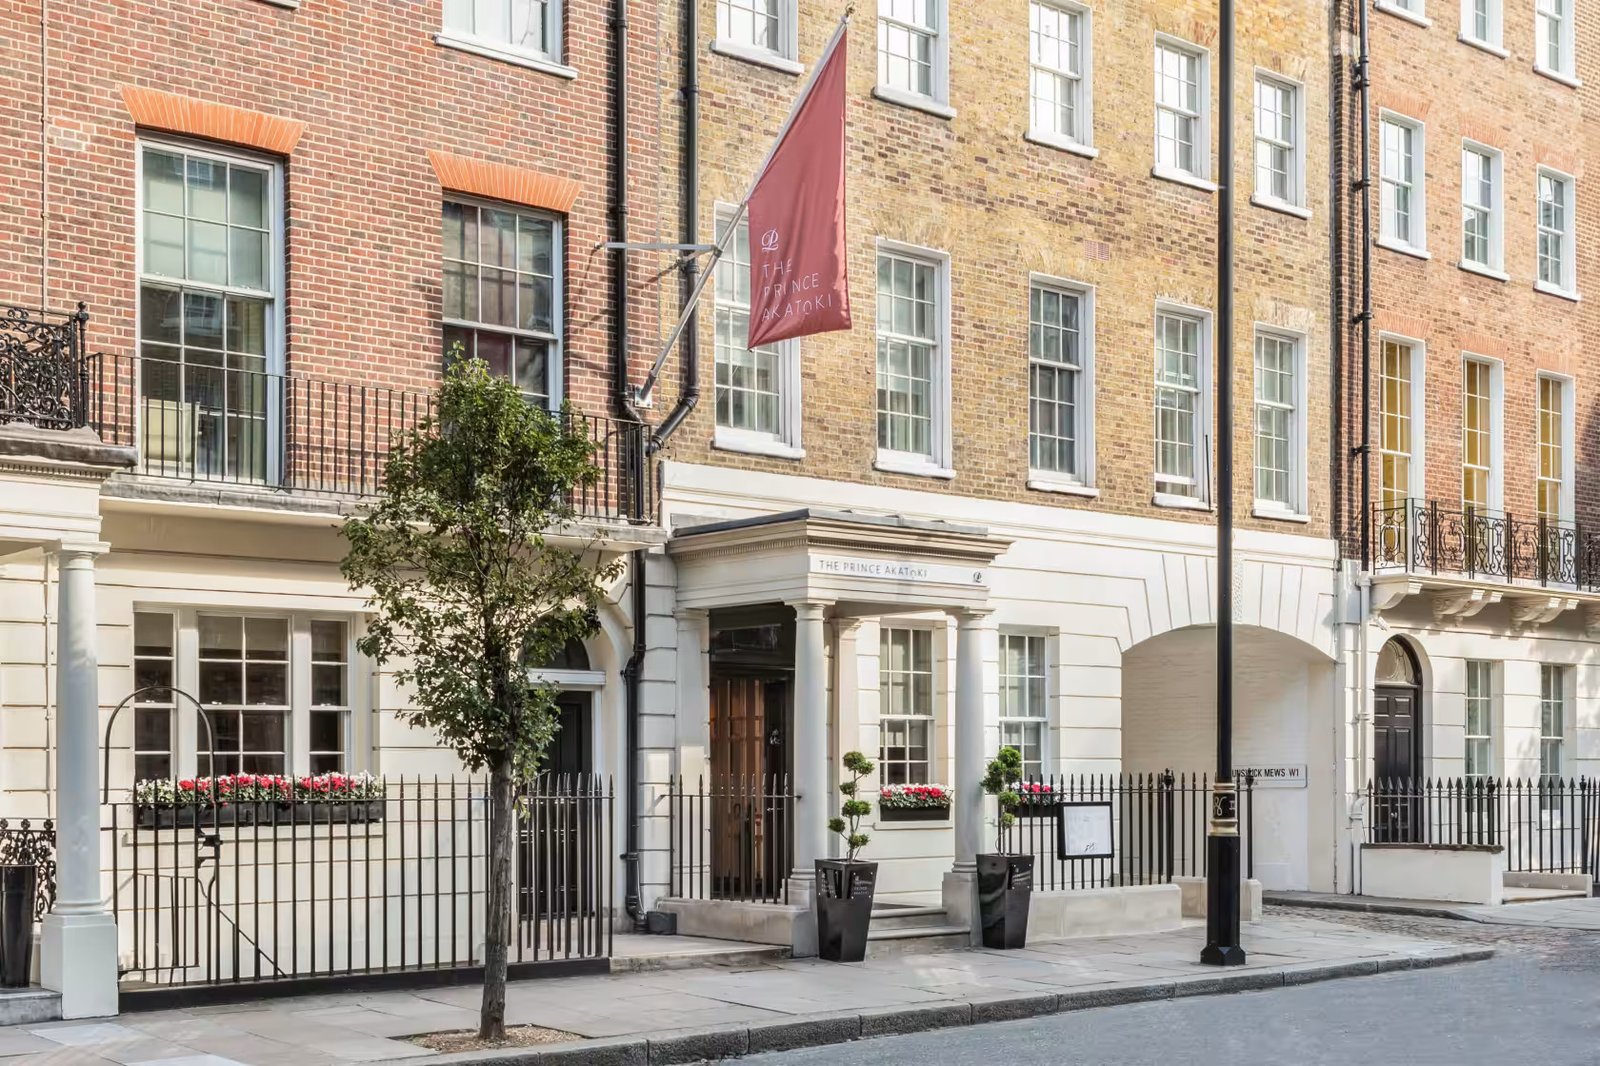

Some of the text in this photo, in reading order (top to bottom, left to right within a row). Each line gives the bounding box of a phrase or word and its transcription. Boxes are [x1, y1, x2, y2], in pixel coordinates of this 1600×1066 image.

[762, 258, 792, 278] THE
[764, 272, 819, 298] PRINCE
[761, 293, 832, 322] AKATOKI
[819, 560, 928, 579] THE PRINCE AKATOKI
[1264, 768, 1286, 777] MEWS
[1289, 768, 1299, 777] W1
